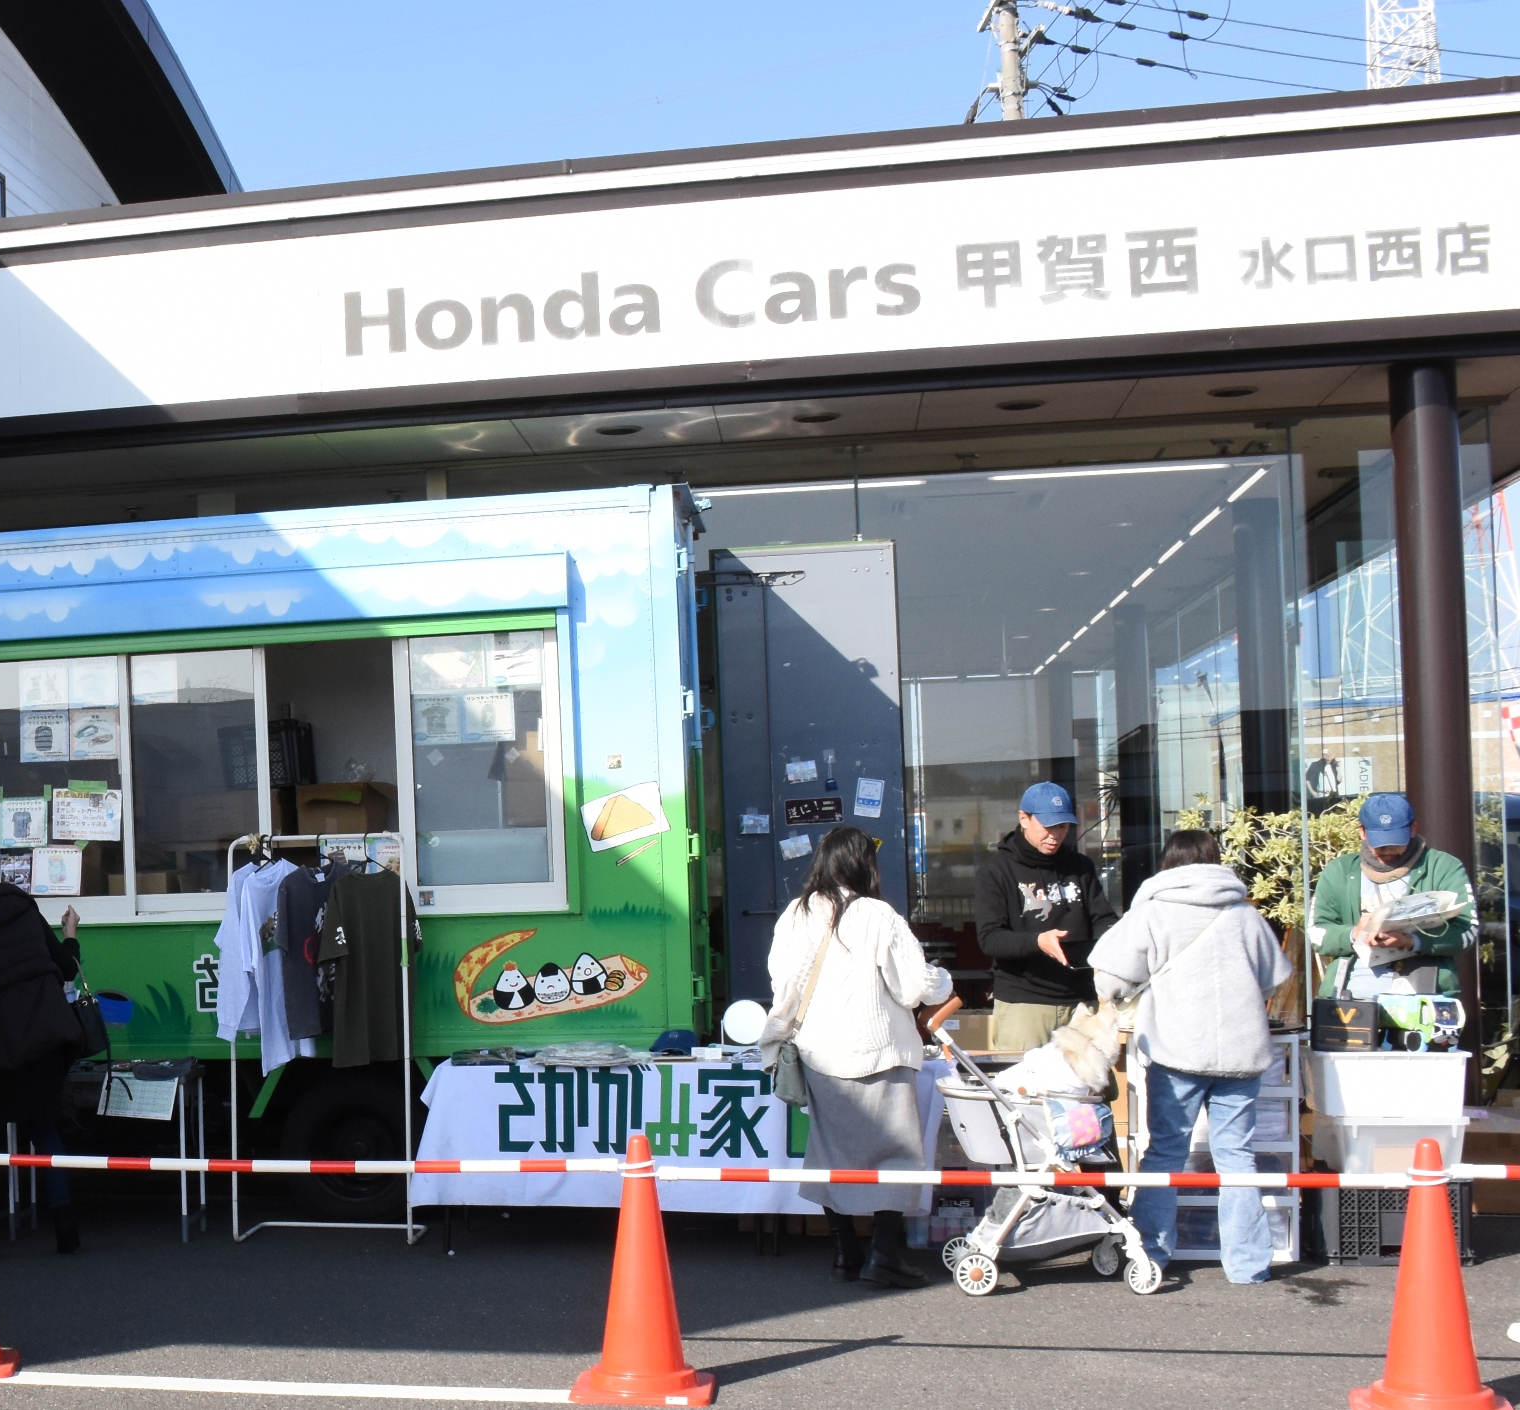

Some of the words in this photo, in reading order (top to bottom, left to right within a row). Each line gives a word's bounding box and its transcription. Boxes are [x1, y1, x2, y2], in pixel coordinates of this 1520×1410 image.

[343, 271, 662, 357] Honda
[694, 258, 921, 329] Cars
[955, 227, 1199, 309] 甲賀西
[1238, 221, 1491, 290] 水口西店
[493, 1061, 772, 1159] さかがみ家
